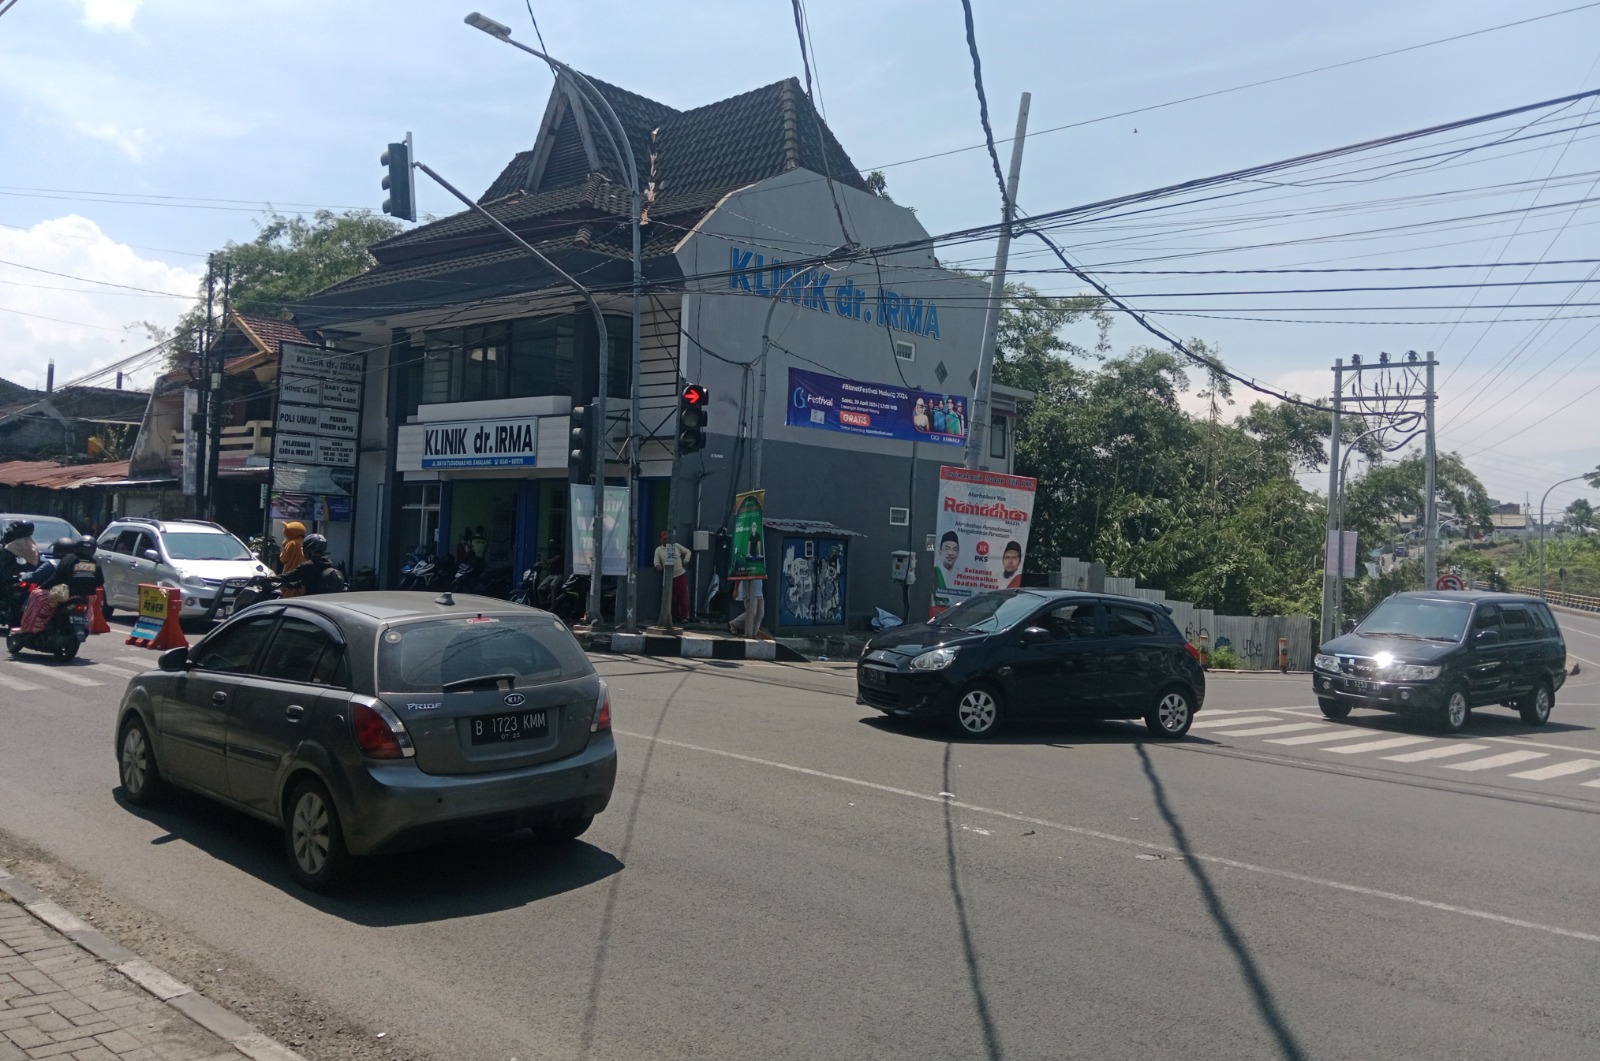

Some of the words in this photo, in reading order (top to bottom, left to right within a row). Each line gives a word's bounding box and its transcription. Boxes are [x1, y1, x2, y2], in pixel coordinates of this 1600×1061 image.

[730, 246, 831, 313] KLINIK
[877, 286, 941, 340] IRMA
[284, 384, 301, 394] HOME
[301, 387, 318, 395] CARE
[341, 386, 357, 394] CARE
[807, 394, 834, 407] Festival
[280, 413, 296, 422] POLI
[296, 416, 317, 425] UMUM
[843, 413, 867, 425] GRATIS
[282, 440, 311, 449] PELAYANAN
[424, 427, 468, 456] KLINIK
[296, 449, 313, 458] MULUT
[968, 491, 996, 500] Marhaban
[944, 497, 1028, 521] Ramadhan
[974, 555, 989, 563] PKS
[964, 567, 993, 576] Selamat
[956, 573, 998, 583] Menunaikan
[953, 579, 978, 588] Ibadah
[979, 582, 999, 590] Puasa
[143, 601, 165, 613] POWER
[406, 702, 442, 711] PRIDE
[475, 720, 483, 735] B
[491, 715, 518, 733] 1723
[523, 712, 546, 728] KMM
